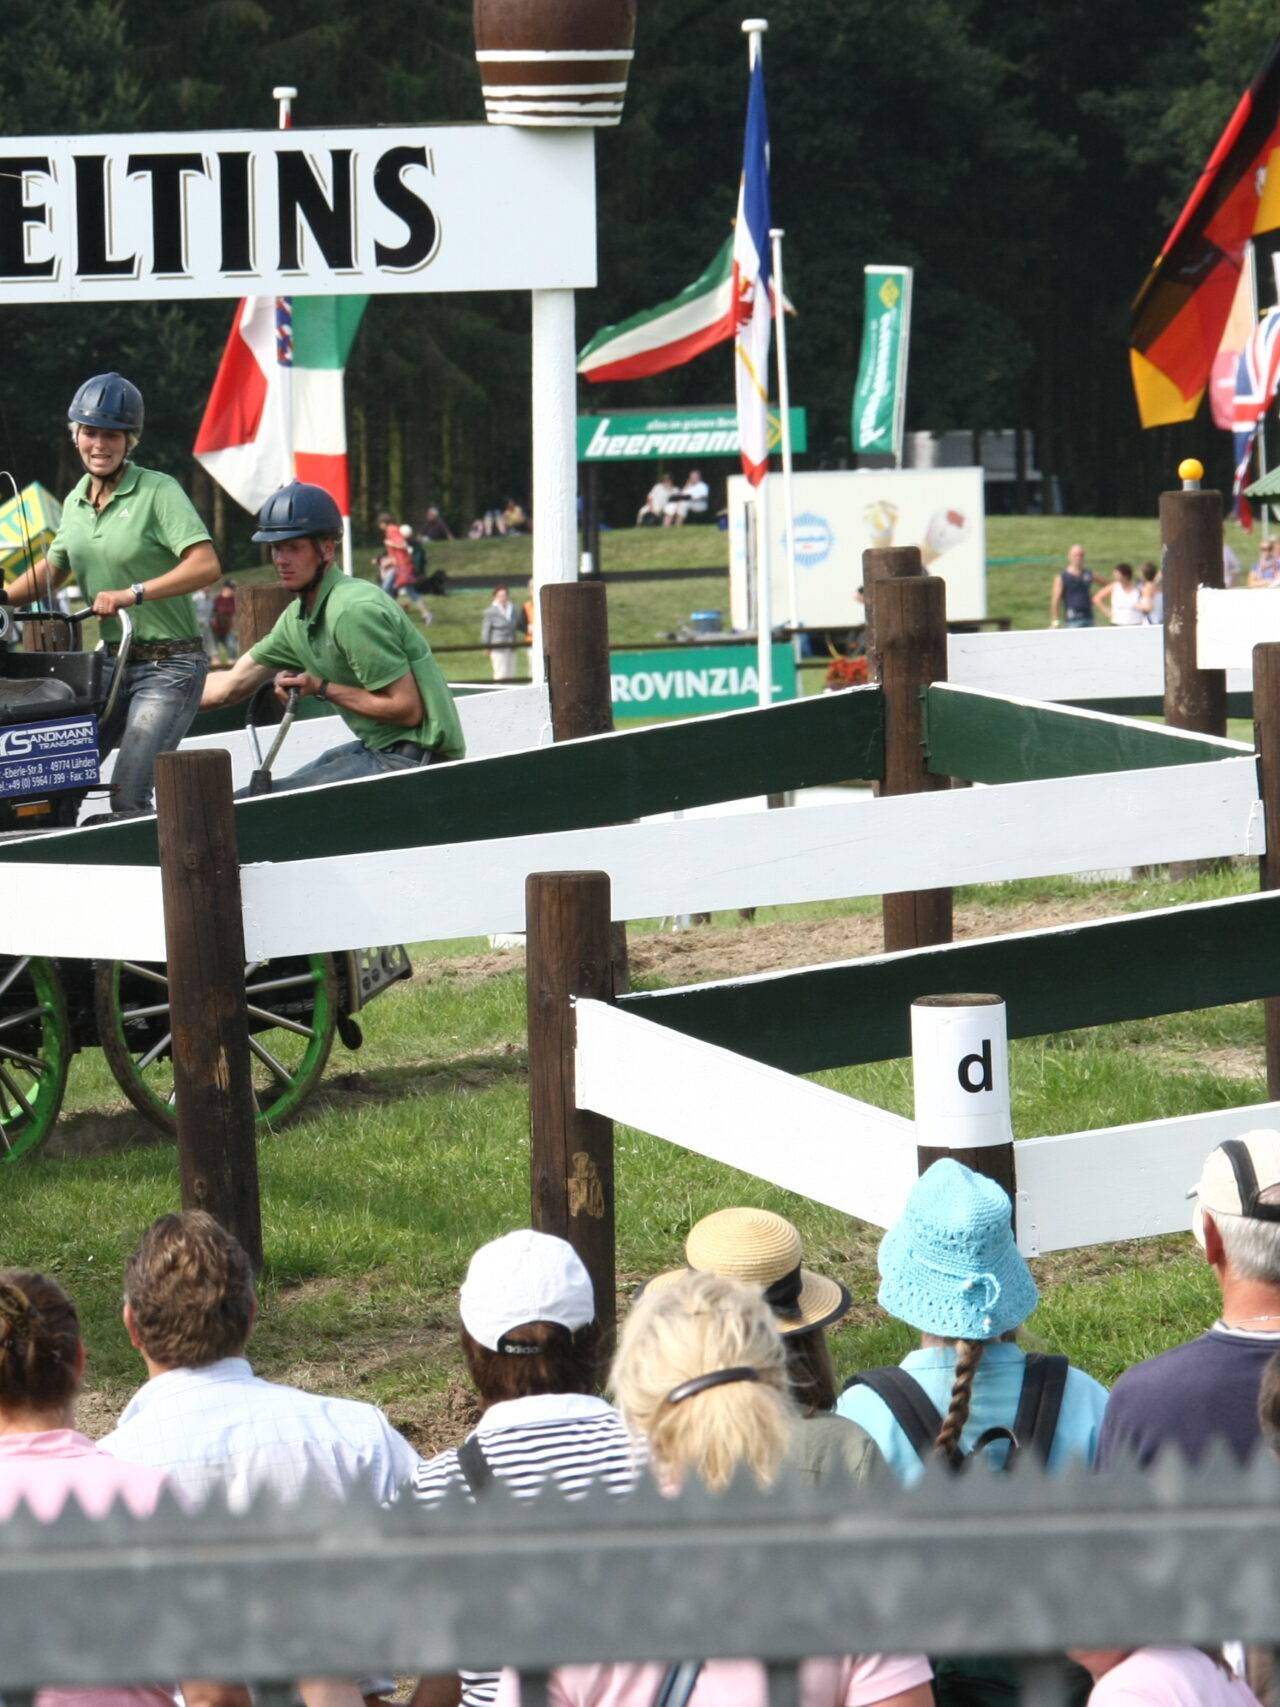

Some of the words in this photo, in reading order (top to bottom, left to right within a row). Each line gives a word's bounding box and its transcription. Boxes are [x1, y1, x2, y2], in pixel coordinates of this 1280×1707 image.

[585, 418, 740, 457] beermann
[610, 665, 782, 703] ROVINZIA
[7, 726, 94, 756] SANDMANN
[39, 737, 94, 750] TRANSPORTE
[32, 775, 48, 787] 5964
[53, 773, 65, 784] 399
[84, 768, 97, 780] 325
[50, 760, 70, 772] 49774
[958, 1039, 993, 1093] d
